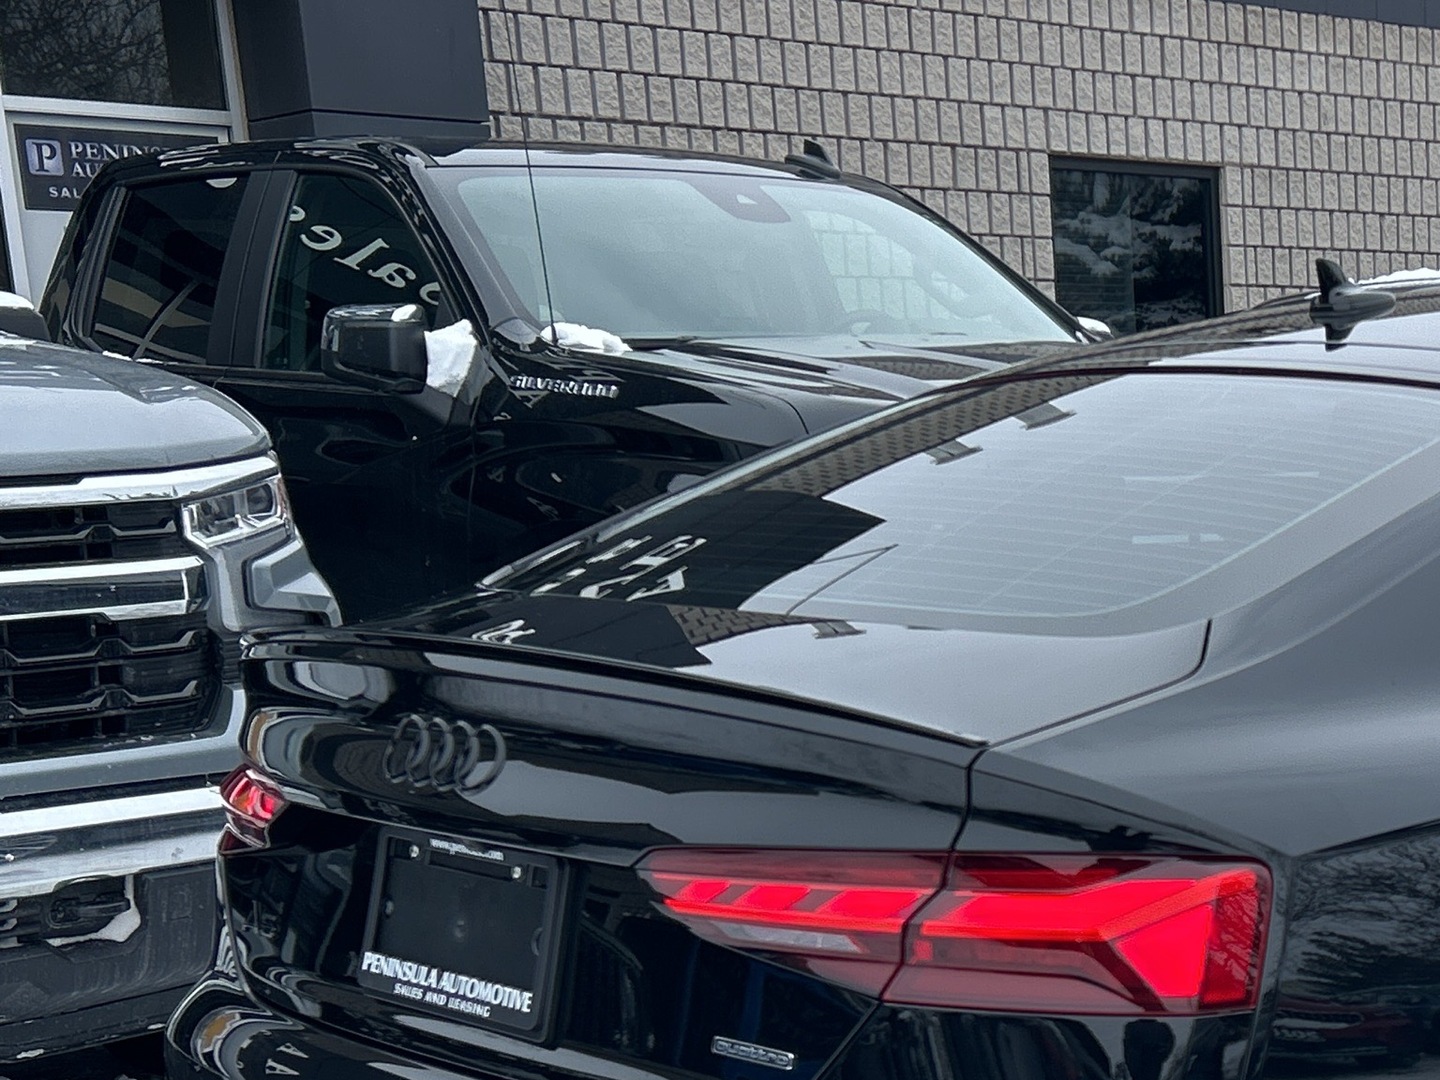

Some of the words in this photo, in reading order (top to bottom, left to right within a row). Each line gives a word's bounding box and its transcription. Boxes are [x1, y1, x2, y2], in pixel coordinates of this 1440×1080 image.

[361, 952, 437, 988] PENINSULA
[437, 971, 534, 1013] AUTOMOTIVE
[393, 983, 424, 1000] SALES
[424, 991, 447, 1006] AND
[447, 997, 491, 1018] LEASING
[716, 1040, 790, 1066] quattro
